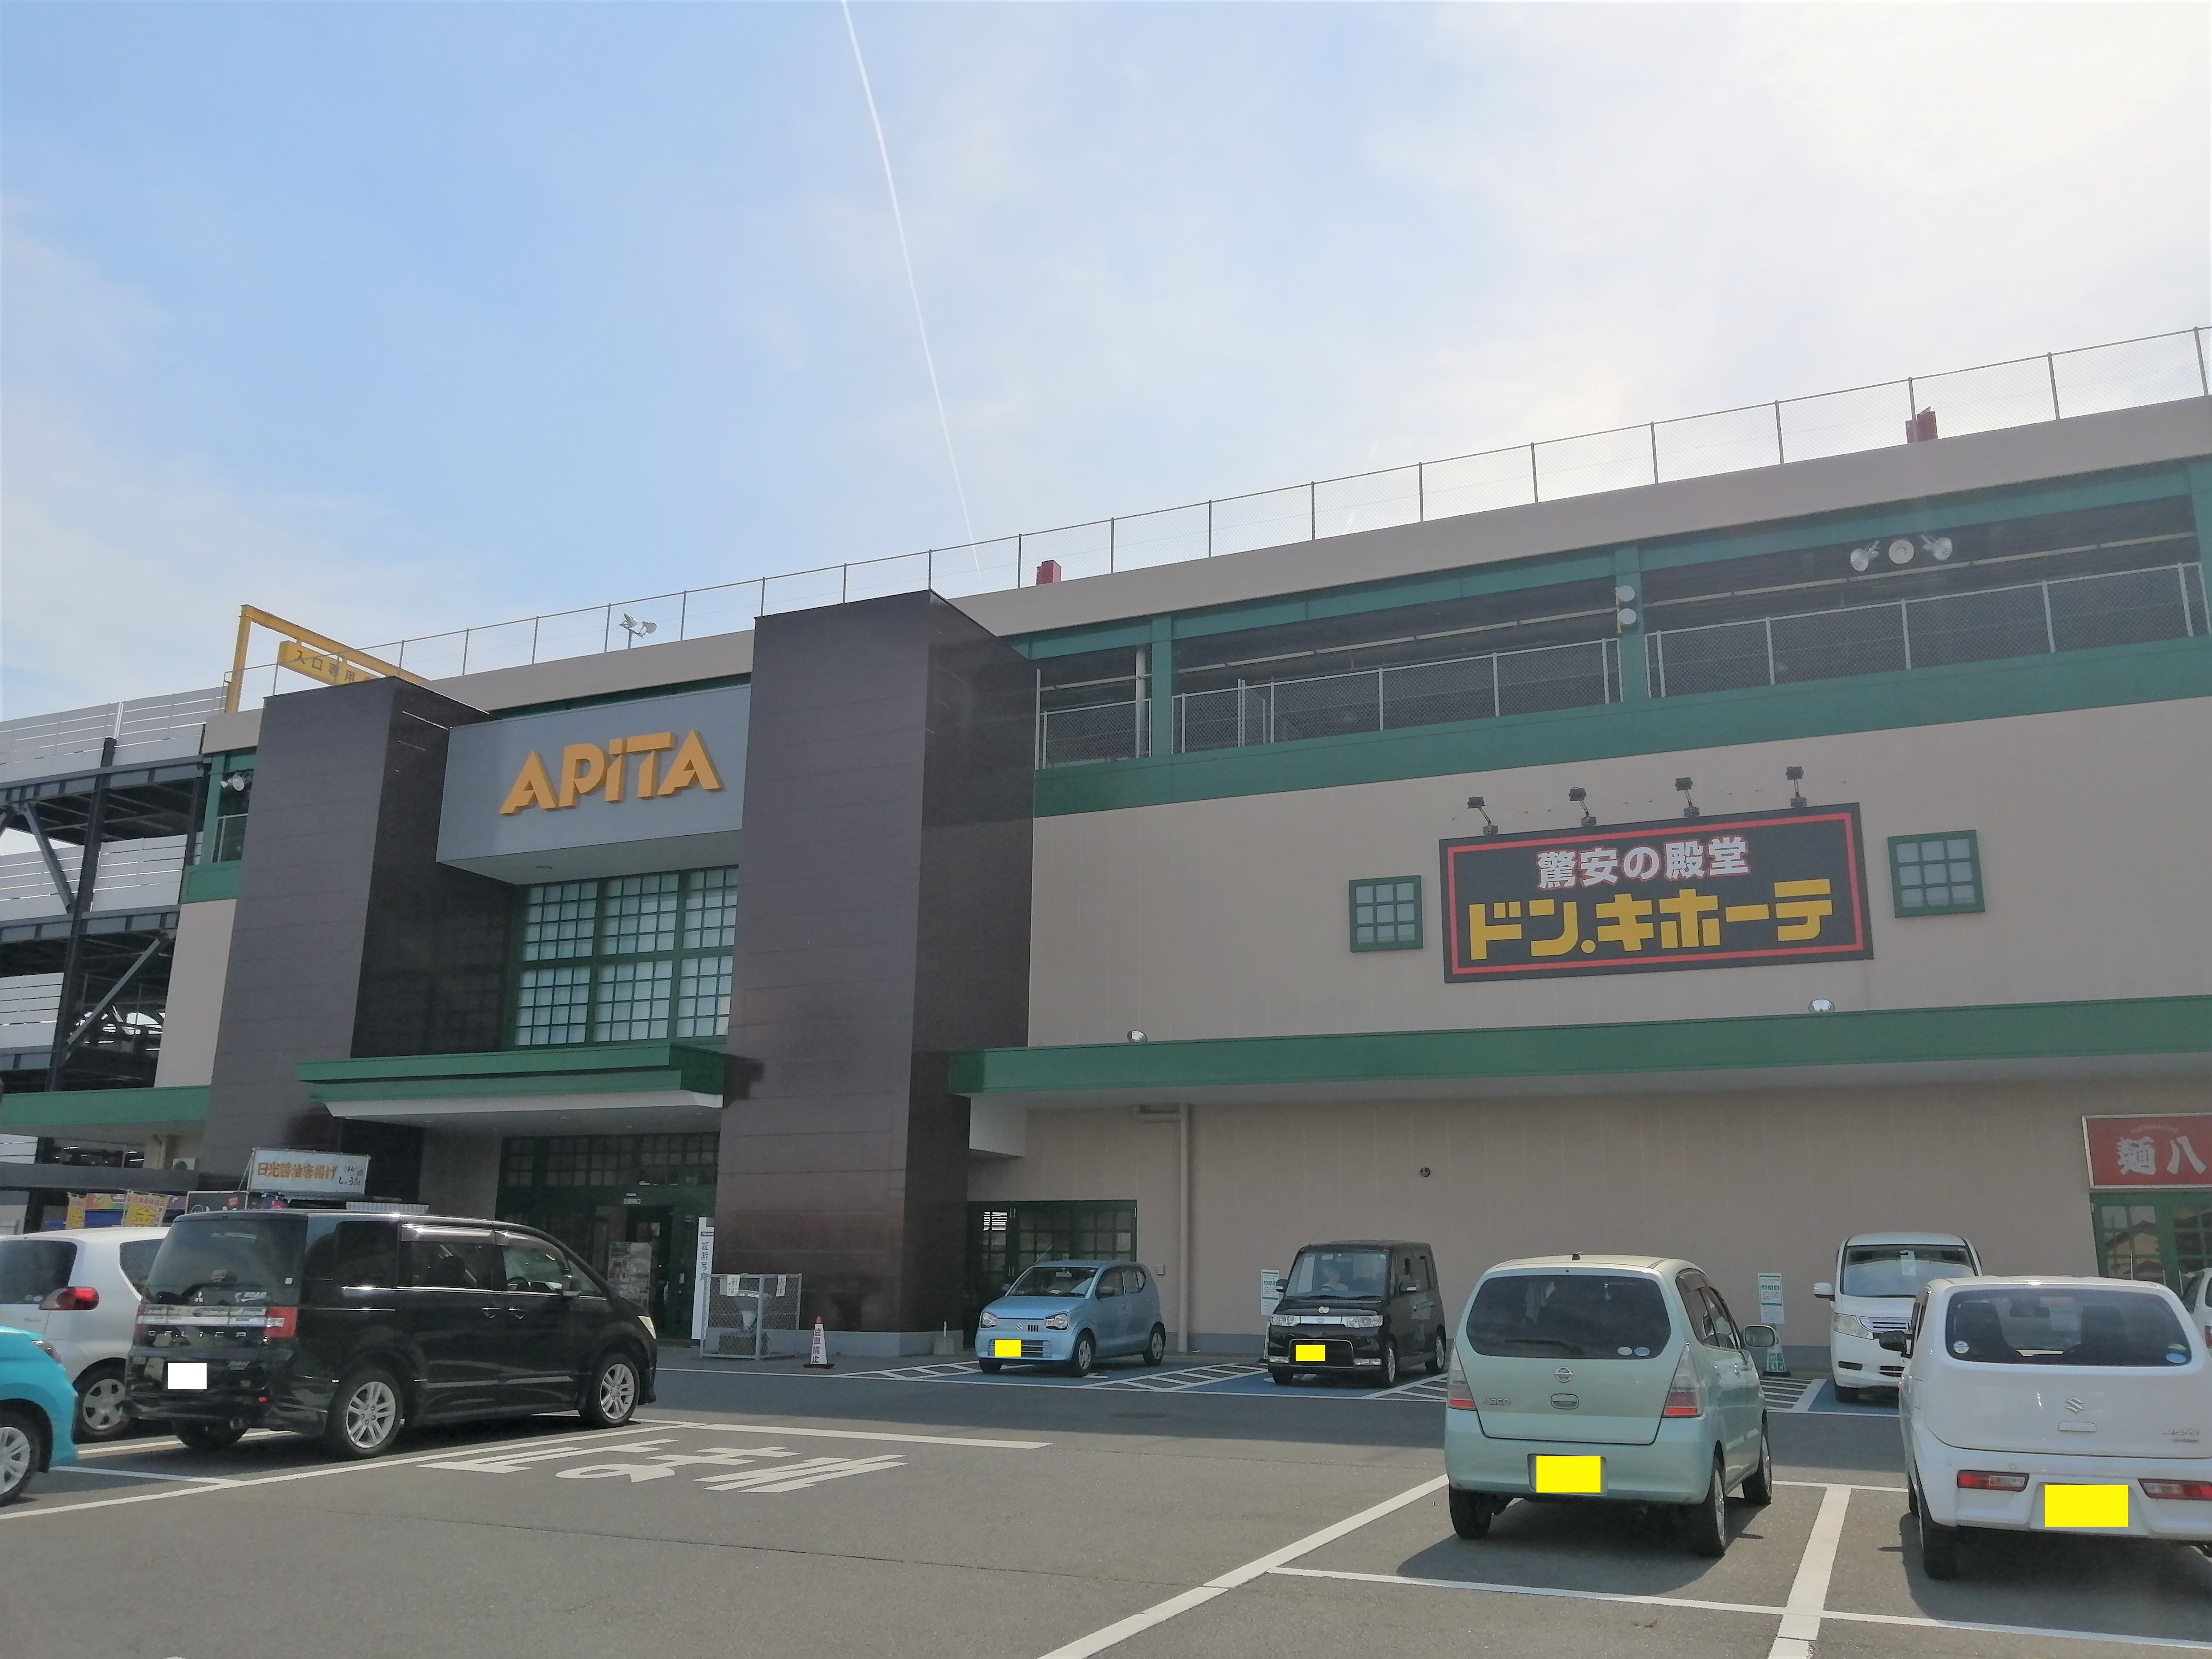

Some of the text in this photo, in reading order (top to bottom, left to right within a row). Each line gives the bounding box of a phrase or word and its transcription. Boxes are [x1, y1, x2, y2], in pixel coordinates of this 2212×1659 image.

[294, 650, 355, 683] 入口専用
[1536, 835, 1749, 889] 驚安の殿堂
[416, 1439, 908, 1493] 止まれ
